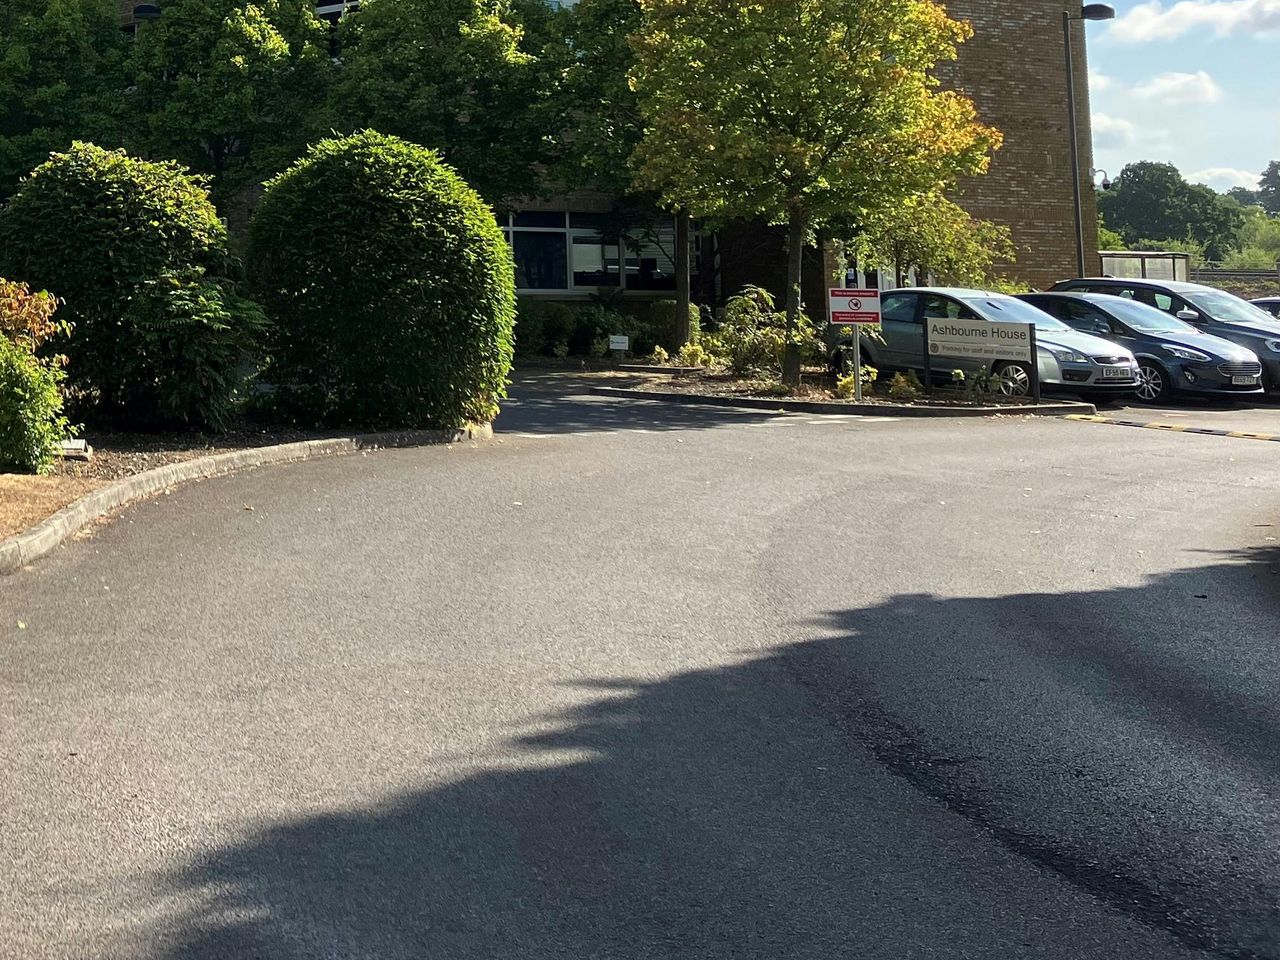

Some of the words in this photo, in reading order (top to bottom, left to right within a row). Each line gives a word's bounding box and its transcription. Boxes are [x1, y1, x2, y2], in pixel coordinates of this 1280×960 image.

[931, 324, 988, 337] Ashbourne
[991, 328, 1027, 340] House
[942, 345, 962, 354] Parking
[971, 346, 983, 354] staff
